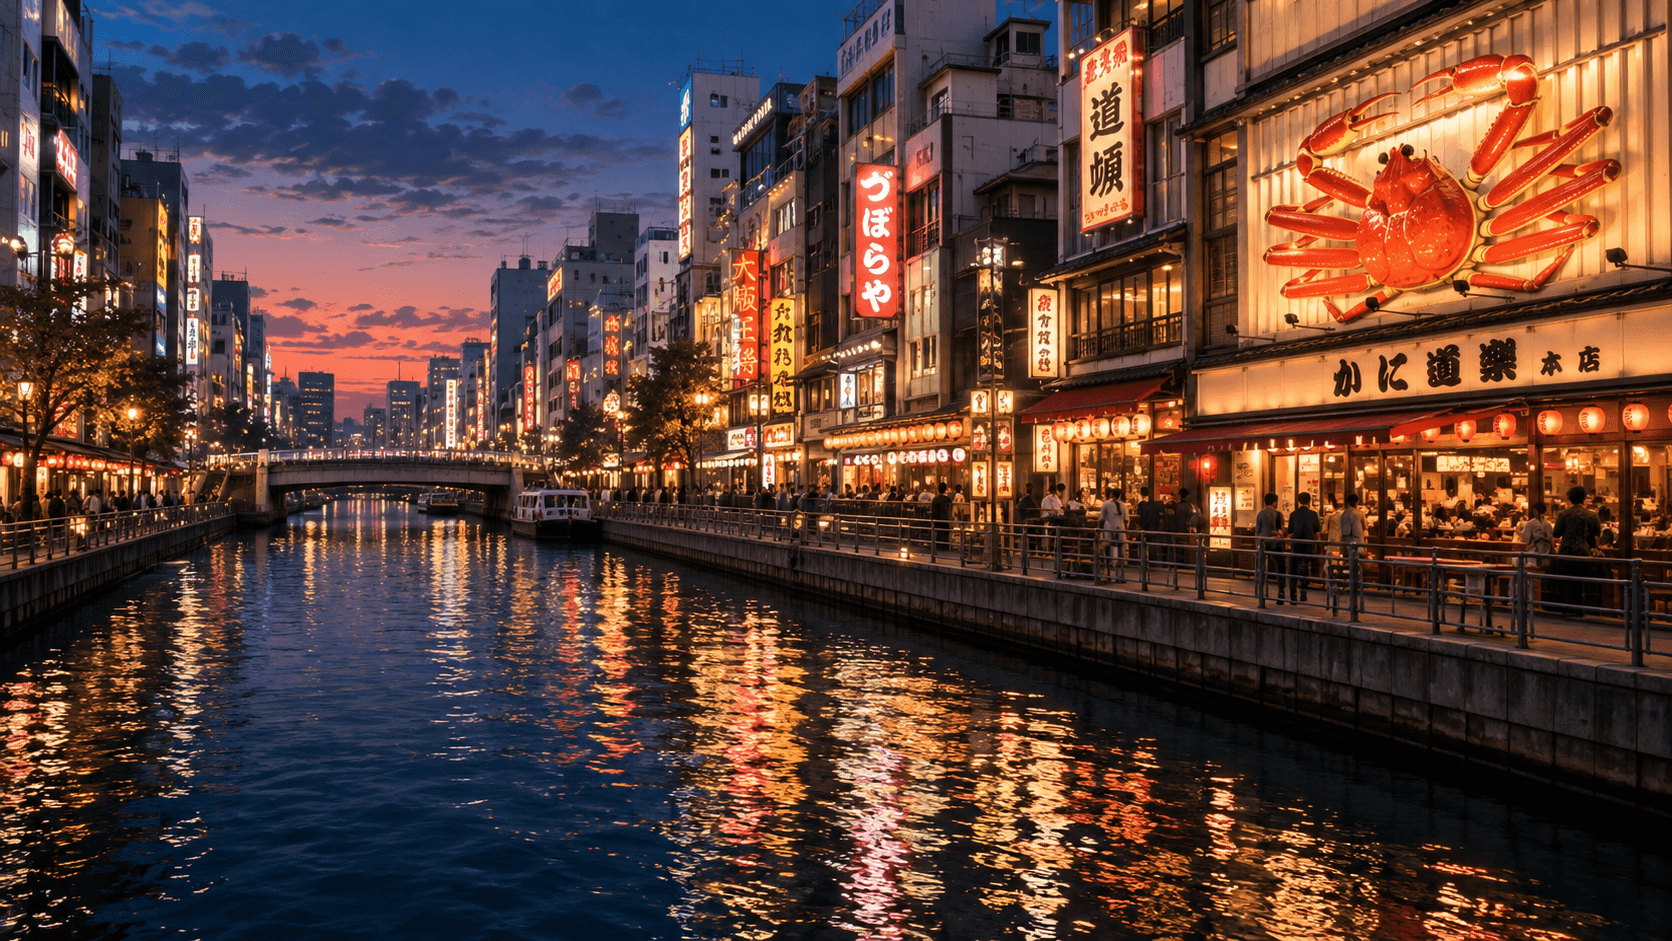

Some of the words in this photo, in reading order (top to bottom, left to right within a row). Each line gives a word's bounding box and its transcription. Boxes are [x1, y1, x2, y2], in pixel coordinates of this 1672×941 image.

[860, 171, 893, 313] づぼらや
[1333, 337, 1517, 397] かに道樂
[1540, 345, 1601, 376] 本店
